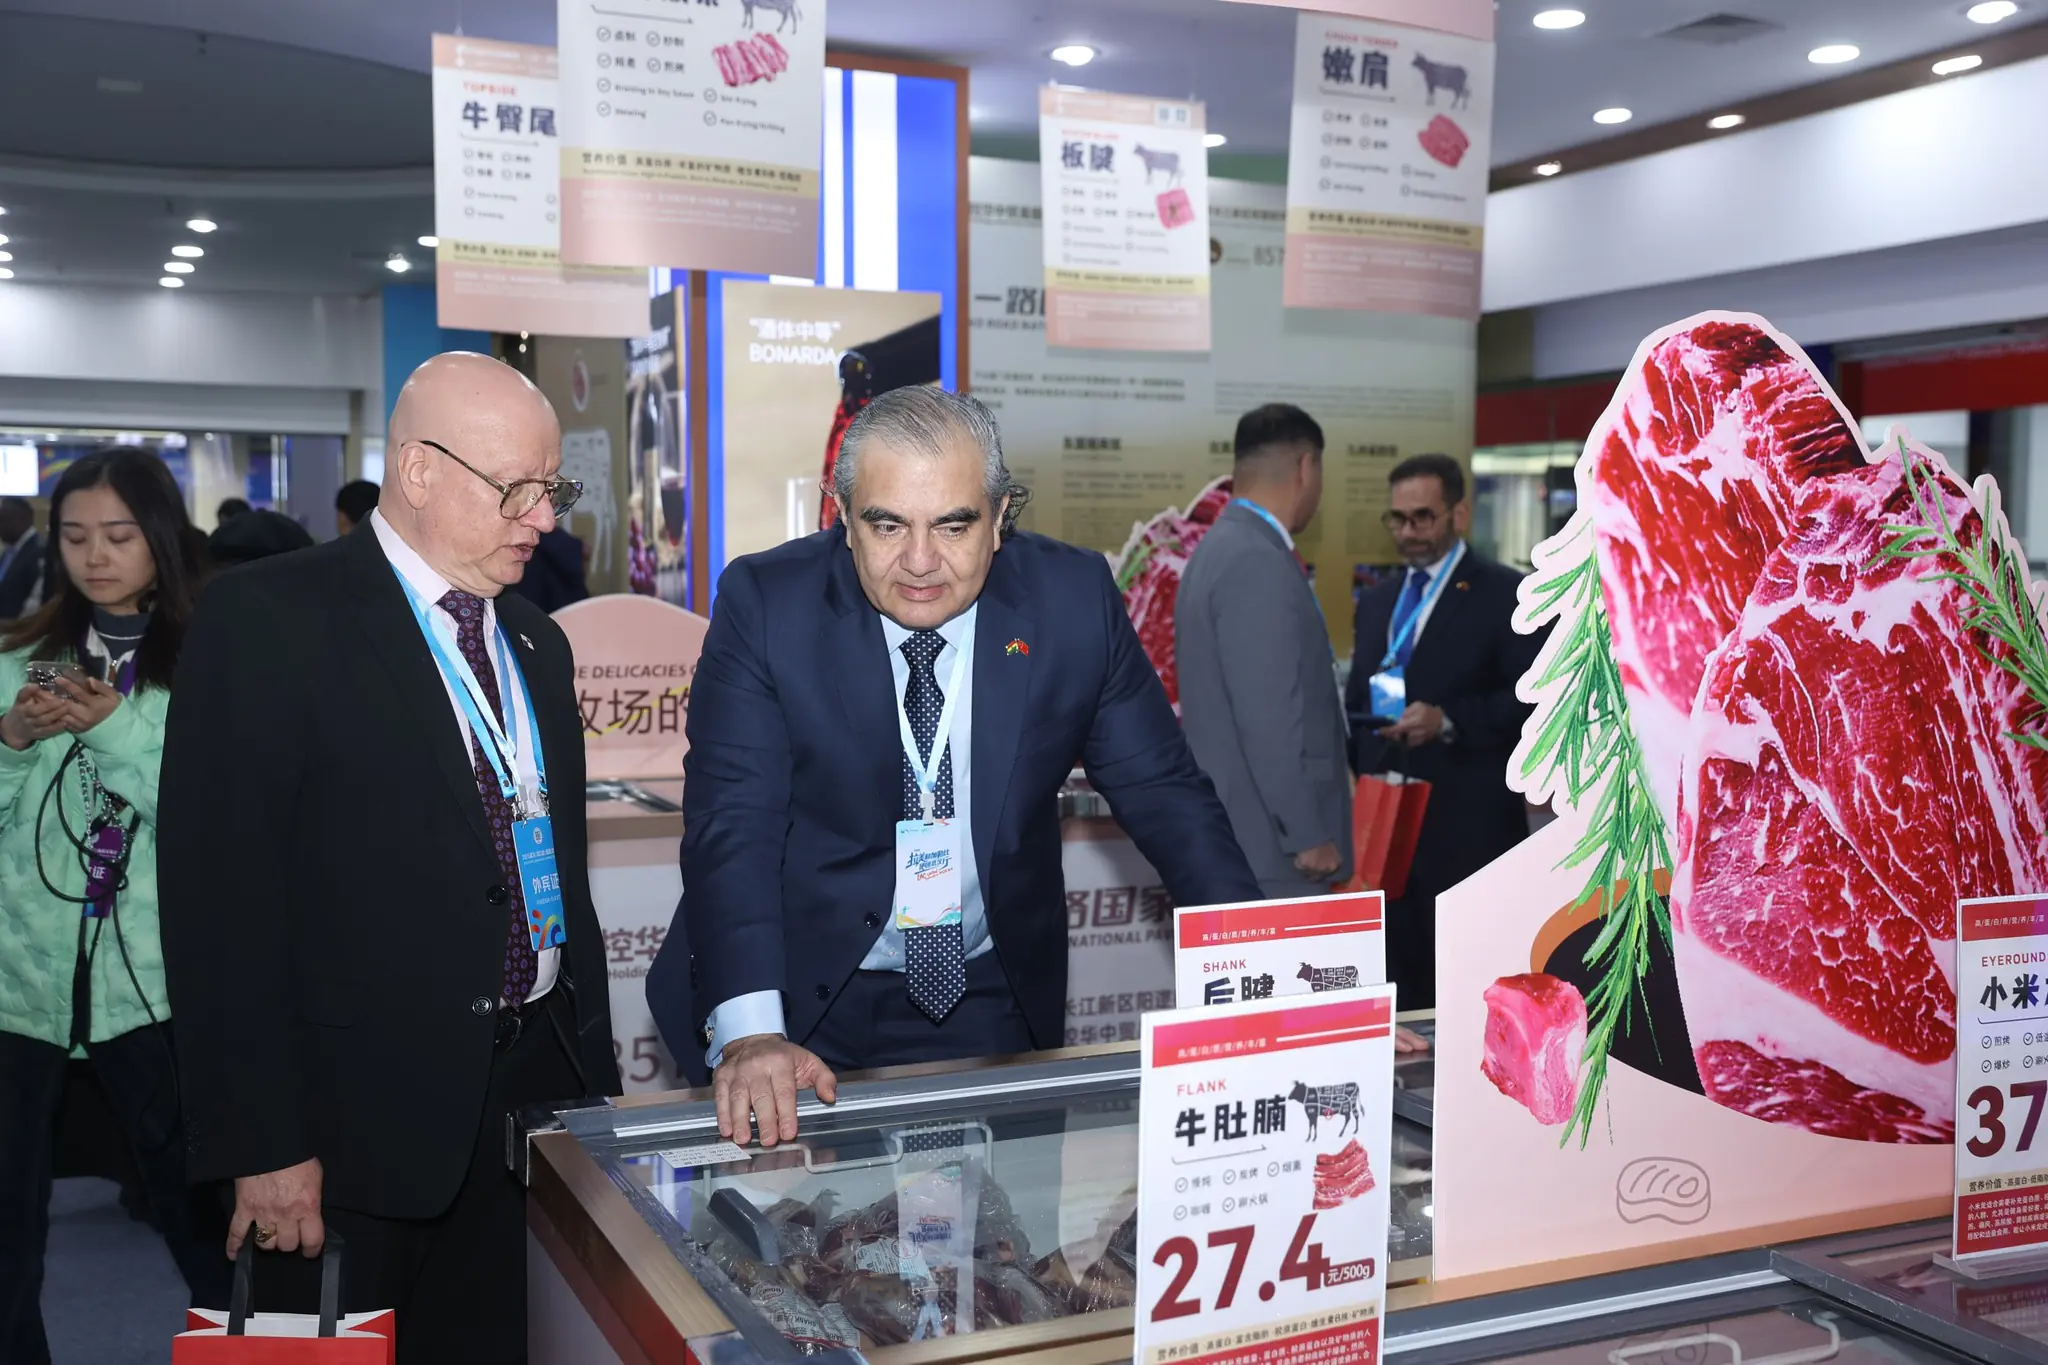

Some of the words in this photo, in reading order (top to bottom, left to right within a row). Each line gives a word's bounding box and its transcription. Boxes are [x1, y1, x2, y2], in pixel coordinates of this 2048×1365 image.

[1322, 45, 1389, 91] 嫩肩
[974, 286, 1044, 316] 一路
[749, 342, 837, 365] BONARDA
[592, 664, 687, 679] DELICACIES
[1068, 932, 1142, 948] NATIONAL
[1203, 959, 1247, 973] SHANK
[1981, 951, 2046, 967] EYEROUND
[1980, 973, 2048, 1011] 小米
[1177, 1078, 1227, 1097] FLANK
[1174, 1094, 1287, 1147] 牛肚腩
[1966, 1080, 2048, 1158] 37
[1969, 1178, 2002, 1192] 营养价值
[1150, 1212, 1330, 1322] 27.4
[1327, 1263, 1371, 1284] 元/500g
[1158, 1342, 1199, 1361] 营养价值
